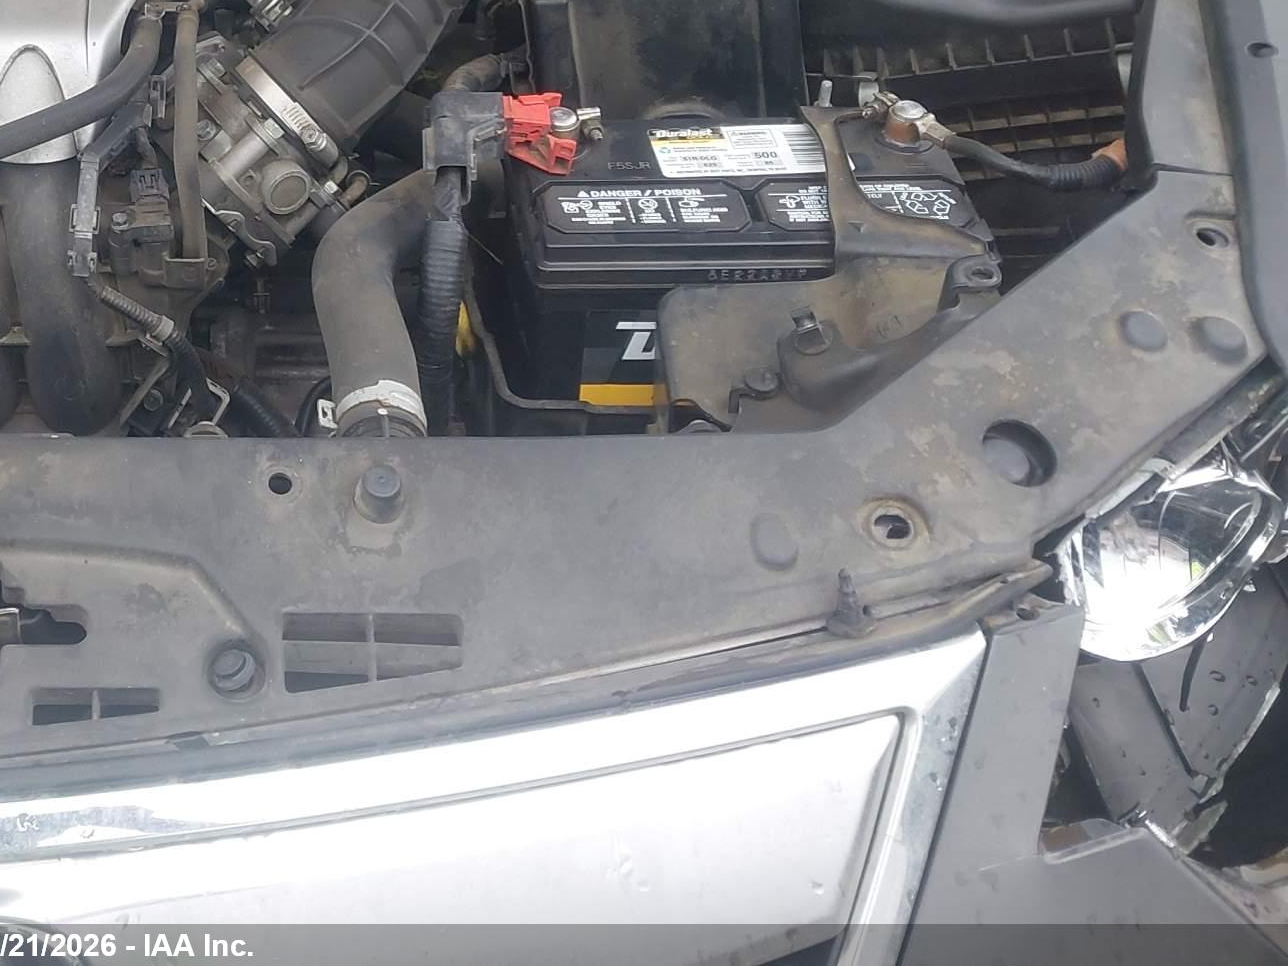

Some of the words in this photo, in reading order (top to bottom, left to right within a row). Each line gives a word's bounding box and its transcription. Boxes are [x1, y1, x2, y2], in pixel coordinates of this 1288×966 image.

[753, 151, 778, 159] 500
[590, 189, 642, 198] DANGER
[644, 189, 653, 197] /
[654, 188, 702, 197] POISON
